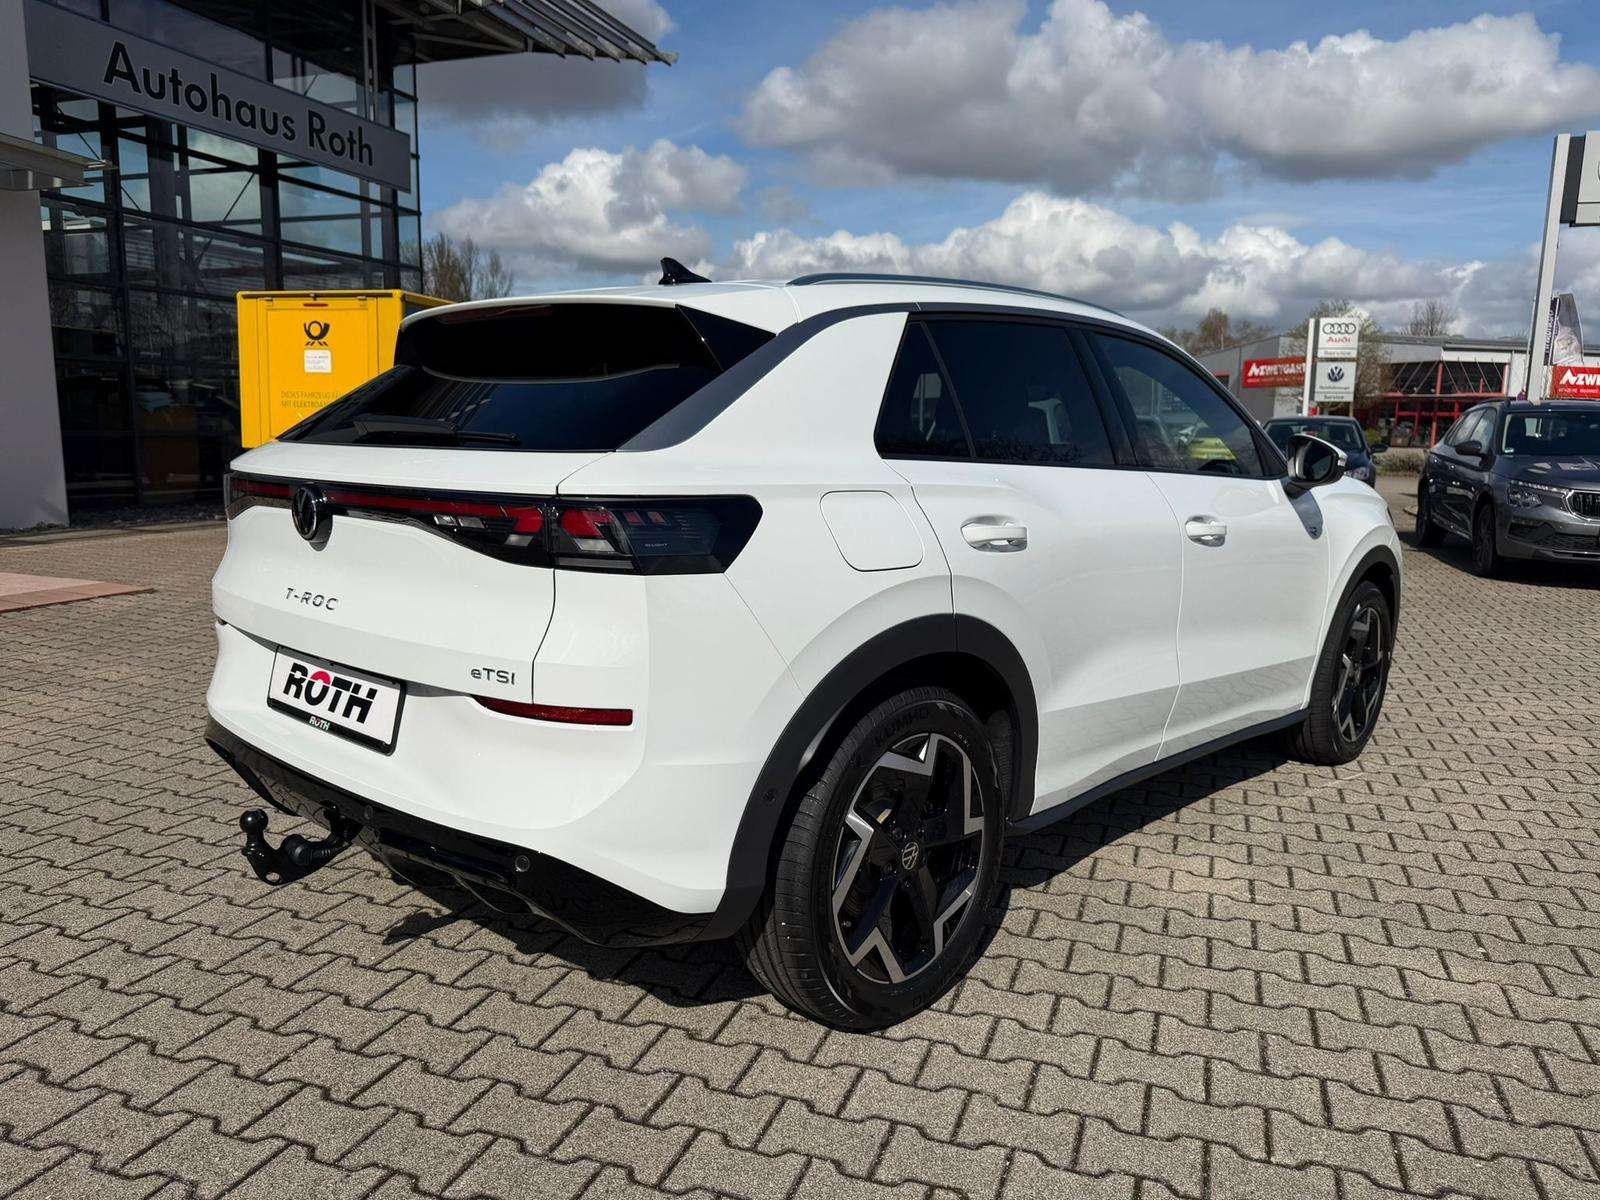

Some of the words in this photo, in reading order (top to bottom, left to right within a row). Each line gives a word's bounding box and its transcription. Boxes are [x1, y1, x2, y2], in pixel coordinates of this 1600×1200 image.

[103, 41, 296, 141] Autohaus
[307, 109, 373, 166] Roth
[1327, 336, 1351, 344] Audi
[286, 587, 338, 610] T-ROC
[471, 667, 515, 685] eTSI
[283, 662, 378, 724] ROTH
[309, 715, 331, 731] ROTH
